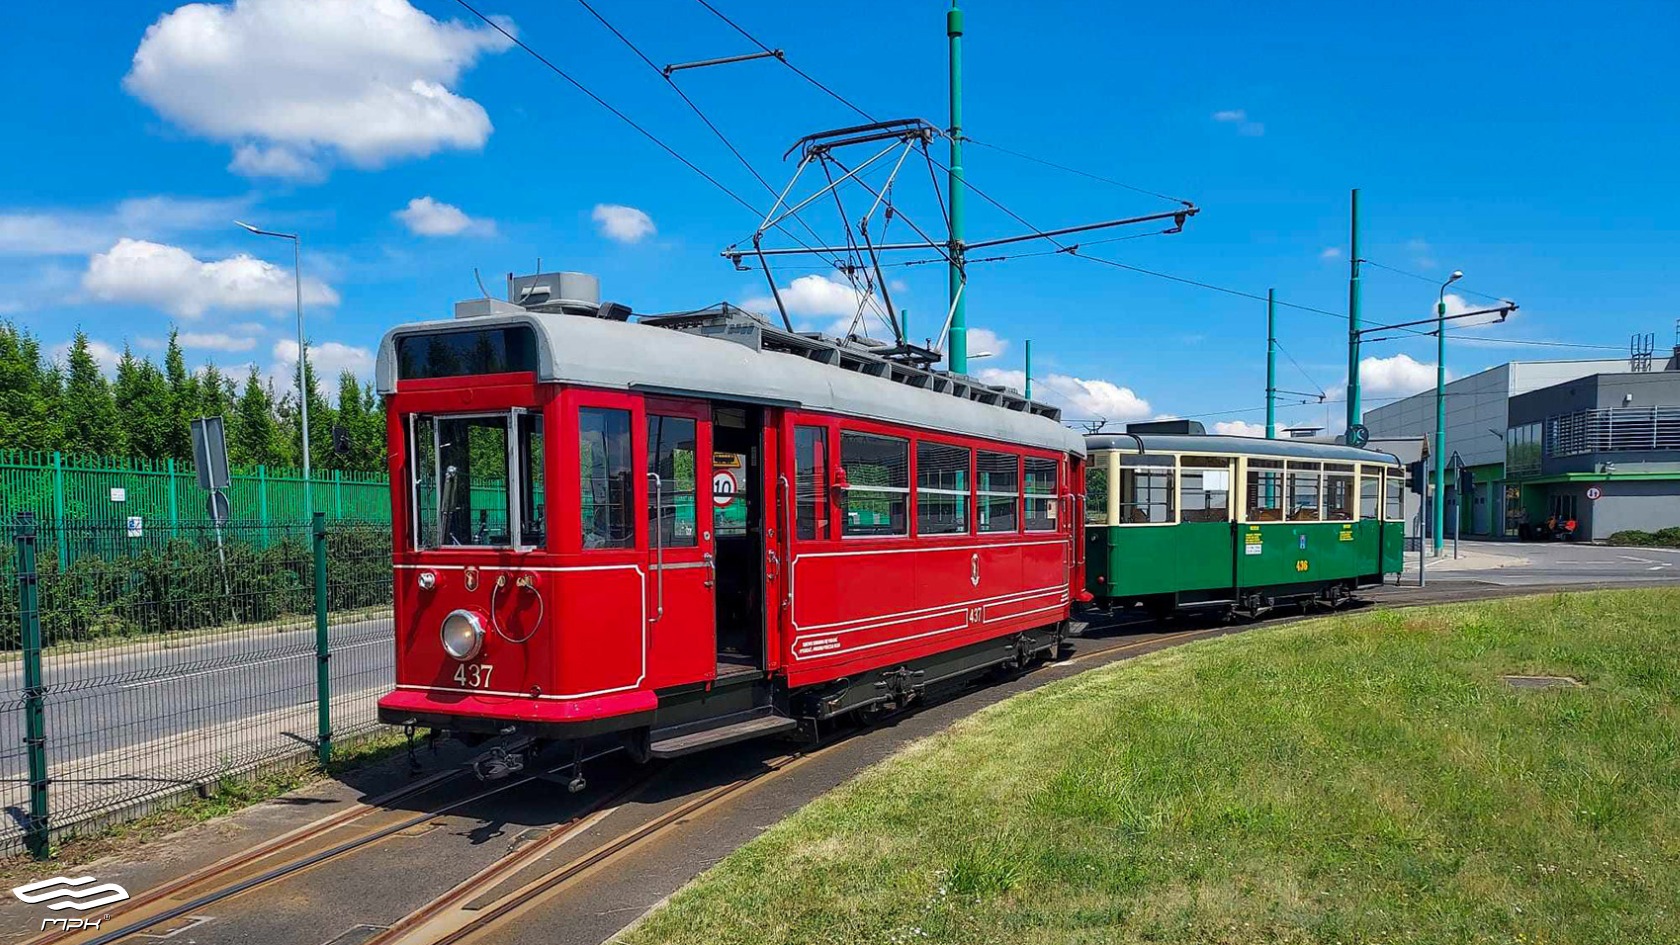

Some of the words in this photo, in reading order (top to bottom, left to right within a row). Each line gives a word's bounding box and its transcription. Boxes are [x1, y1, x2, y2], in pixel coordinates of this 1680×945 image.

[715, 480, 731, 494] 10
[1296, 559, 1308, 571] 436
[969, 607, 982, 624] 437
[454, 664, 493, 687] 437
